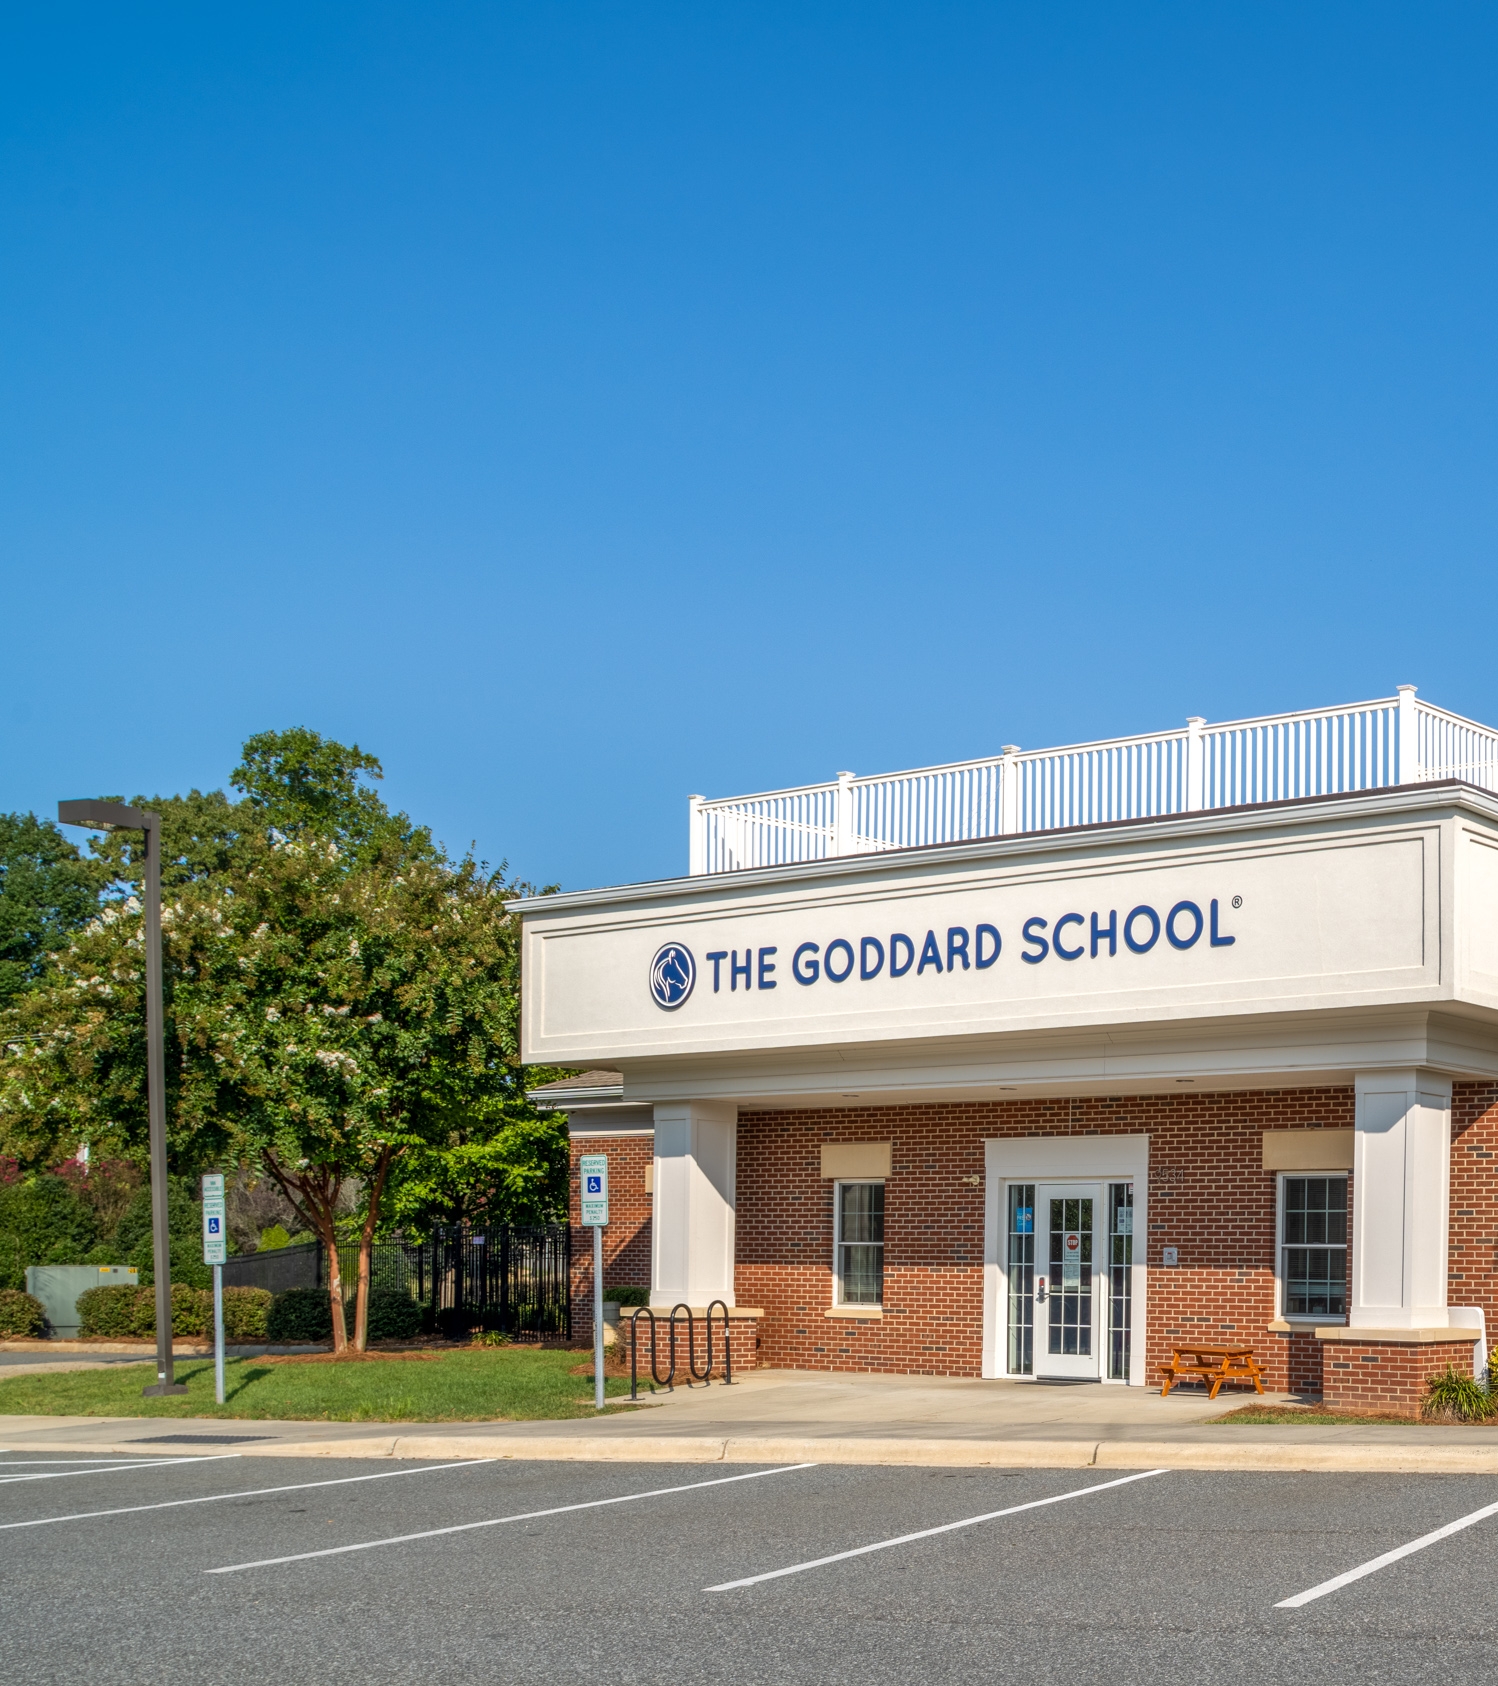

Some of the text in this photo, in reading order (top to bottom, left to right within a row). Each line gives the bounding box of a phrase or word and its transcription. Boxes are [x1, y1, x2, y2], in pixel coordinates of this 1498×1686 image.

[706, 946, 778, 993] THE
[792, 923, 1003, 986] GODDARD
[1155, 1168, 1184, 1182] 9534
